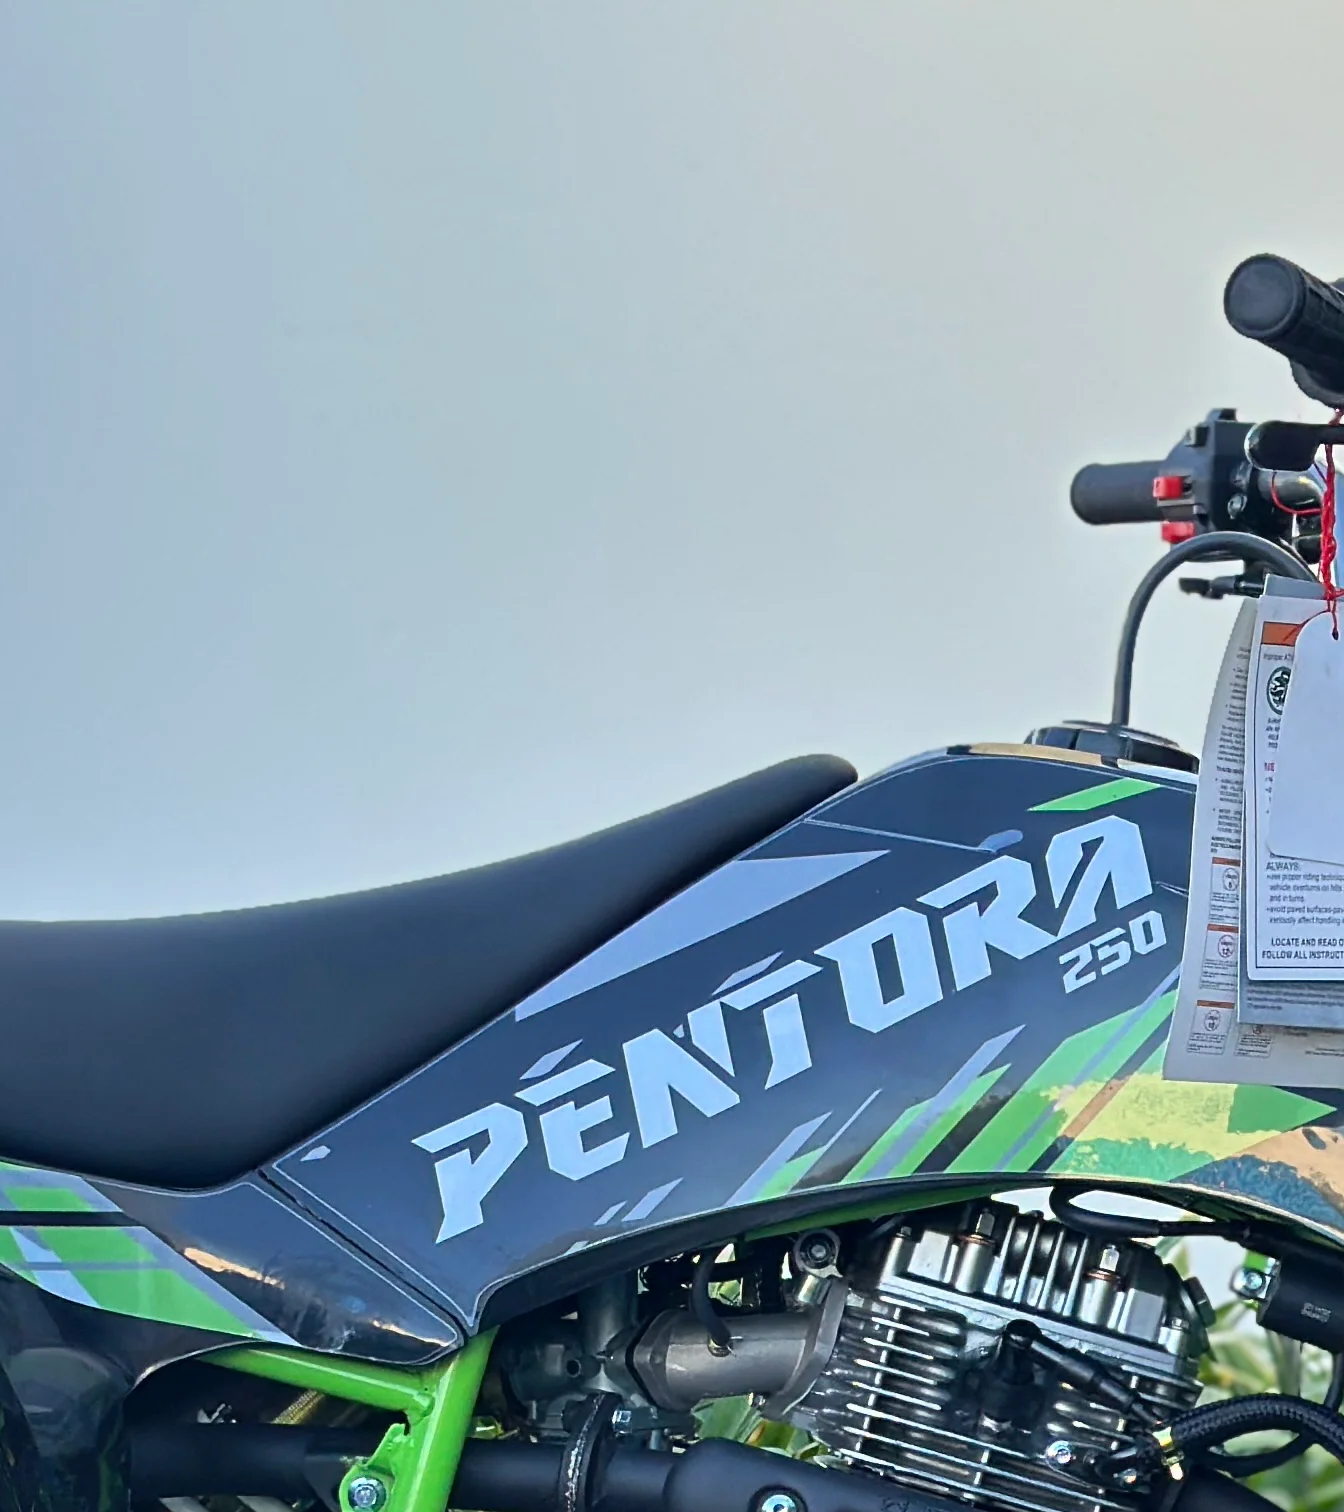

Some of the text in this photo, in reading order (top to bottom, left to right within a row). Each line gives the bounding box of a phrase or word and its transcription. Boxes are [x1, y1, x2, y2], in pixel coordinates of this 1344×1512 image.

[1059, 910, 1167, 994] 250
[1261, 950, 1293, 960] FOLLOW
[1293, 950, 1308, 960] ALL
[1271, 937, 1300, 947] LOCATE
[1300, 937, 1316, 947] AND
[1317, 937, 1337, 947] READ
[412, 815, 1152, 1242] PENTORA
